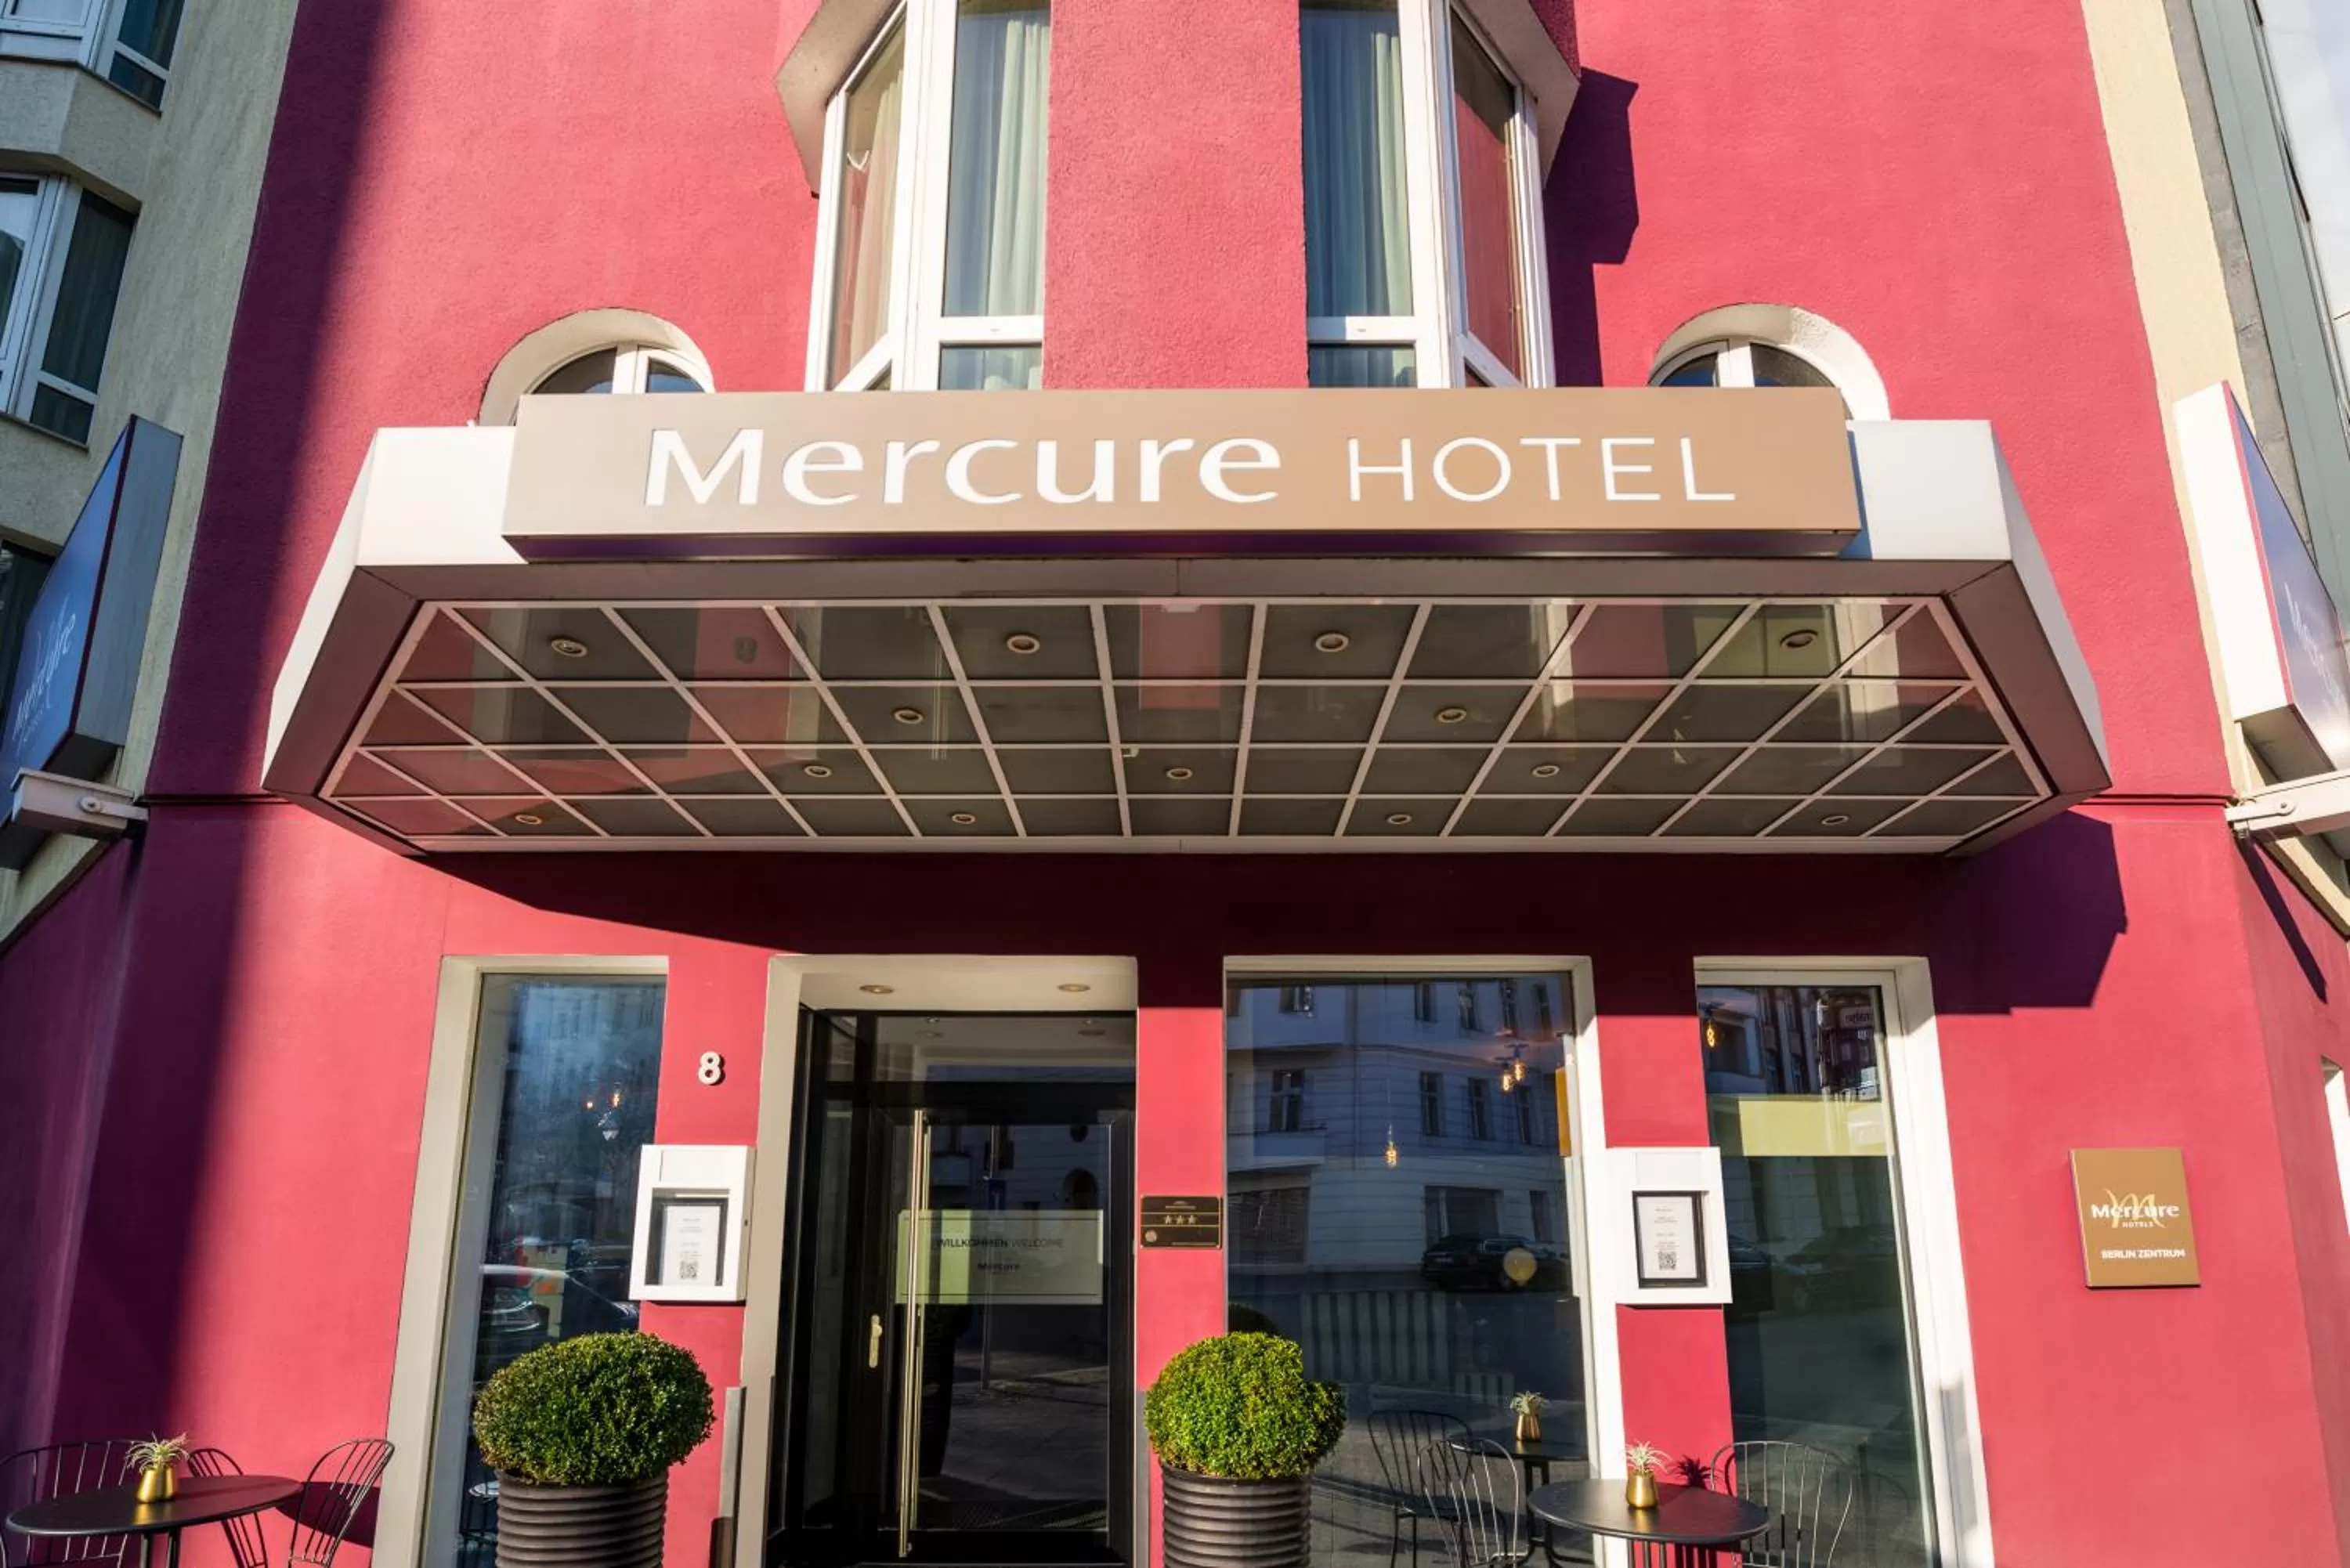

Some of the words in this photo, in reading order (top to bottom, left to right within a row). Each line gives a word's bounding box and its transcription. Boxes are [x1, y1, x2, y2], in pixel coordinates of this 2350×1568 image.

[644, 428, 1282, 508] Mercure
[1347, 435, 1737, 504] HOTEL
[698, 1051, 721, 1085] 8
[2092, 1204, 2180, 1218] Mercure
[2101, 1249, 2135, 1259] BERLIN
[2138, 1248, 2186, 1259] ZENTRUM
